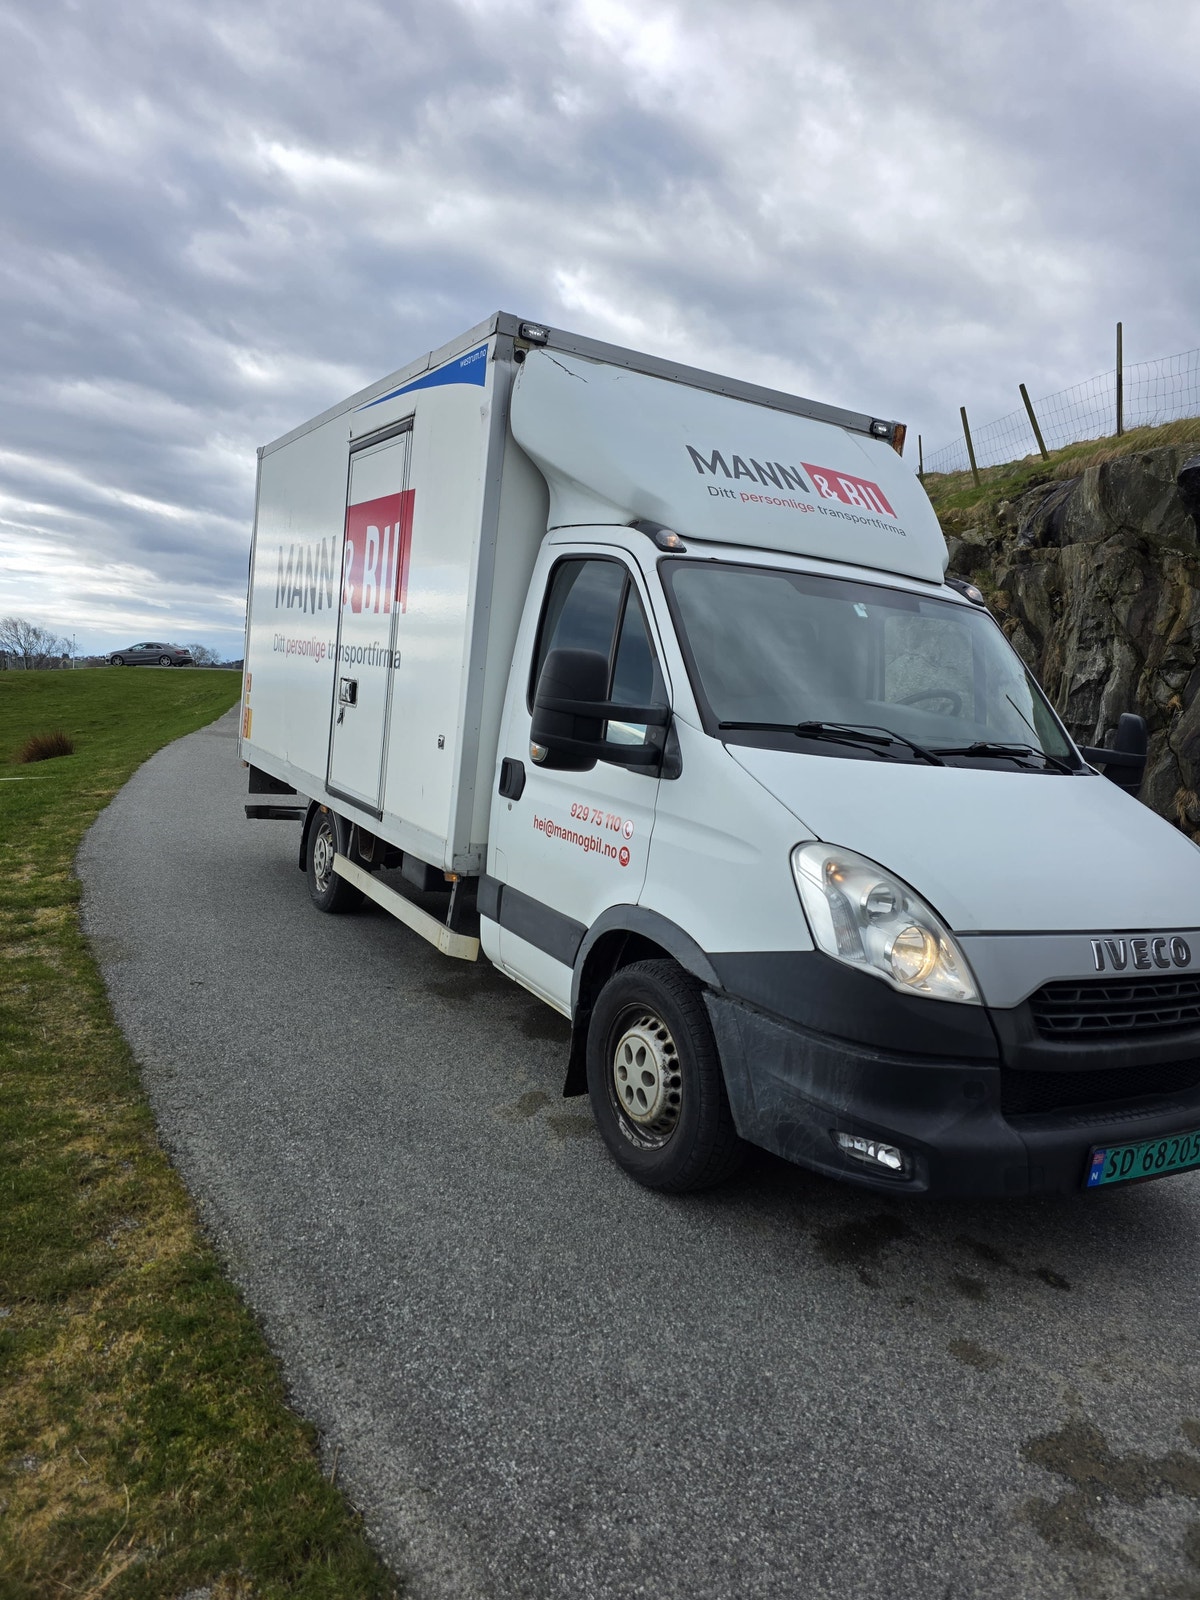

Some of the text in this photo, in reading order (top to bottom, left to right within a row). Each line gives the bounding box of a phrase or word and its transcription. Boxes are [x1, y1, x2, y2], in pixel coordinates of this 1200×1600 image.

[686, 445, 895, 517] MANN & BIL
[707, 486, 906, 537] Ditt personlige transportfirma
[275, 535, 336, 615] MANN
[273, 633, 402, 669] Ditt personlige trnsportfirma
[533, 815, 617, 859] hei@mannogbil.no
[570, 803, 621, 832] 929 75 110
[1090, 936, 1191, 971] IVECO
[1091, 1172, 1099, 1181] N
[1105, 1135, 1200, 1178] SD 68205
